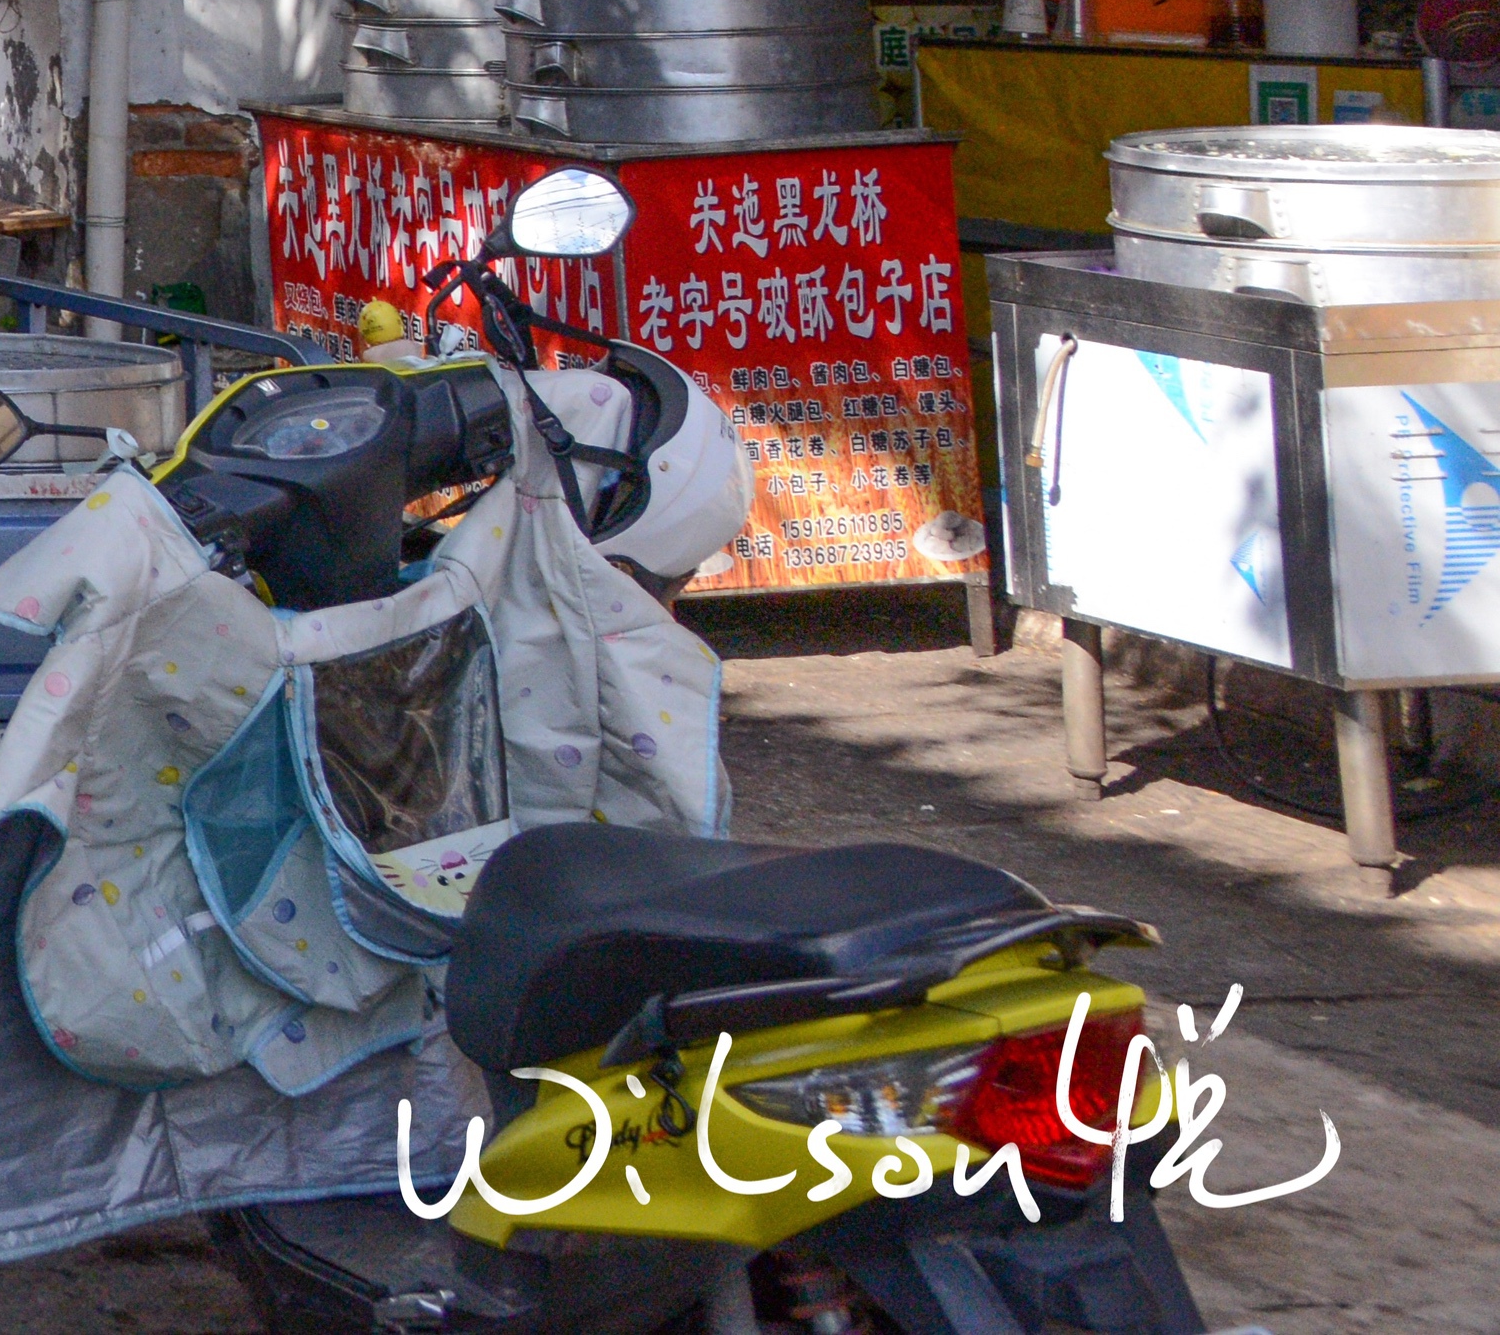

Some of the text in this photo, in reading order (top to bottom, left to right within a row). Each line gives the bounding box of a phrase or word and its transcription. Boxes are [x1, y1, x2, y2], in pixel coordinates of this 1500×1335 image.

[638, 252, 953, 353] 老字号破酥包子店
[780, 513, 903, 540] 15912611885
[734, 534, 773, 560] 电话
[781, 542, 907, 568] 13368723935
